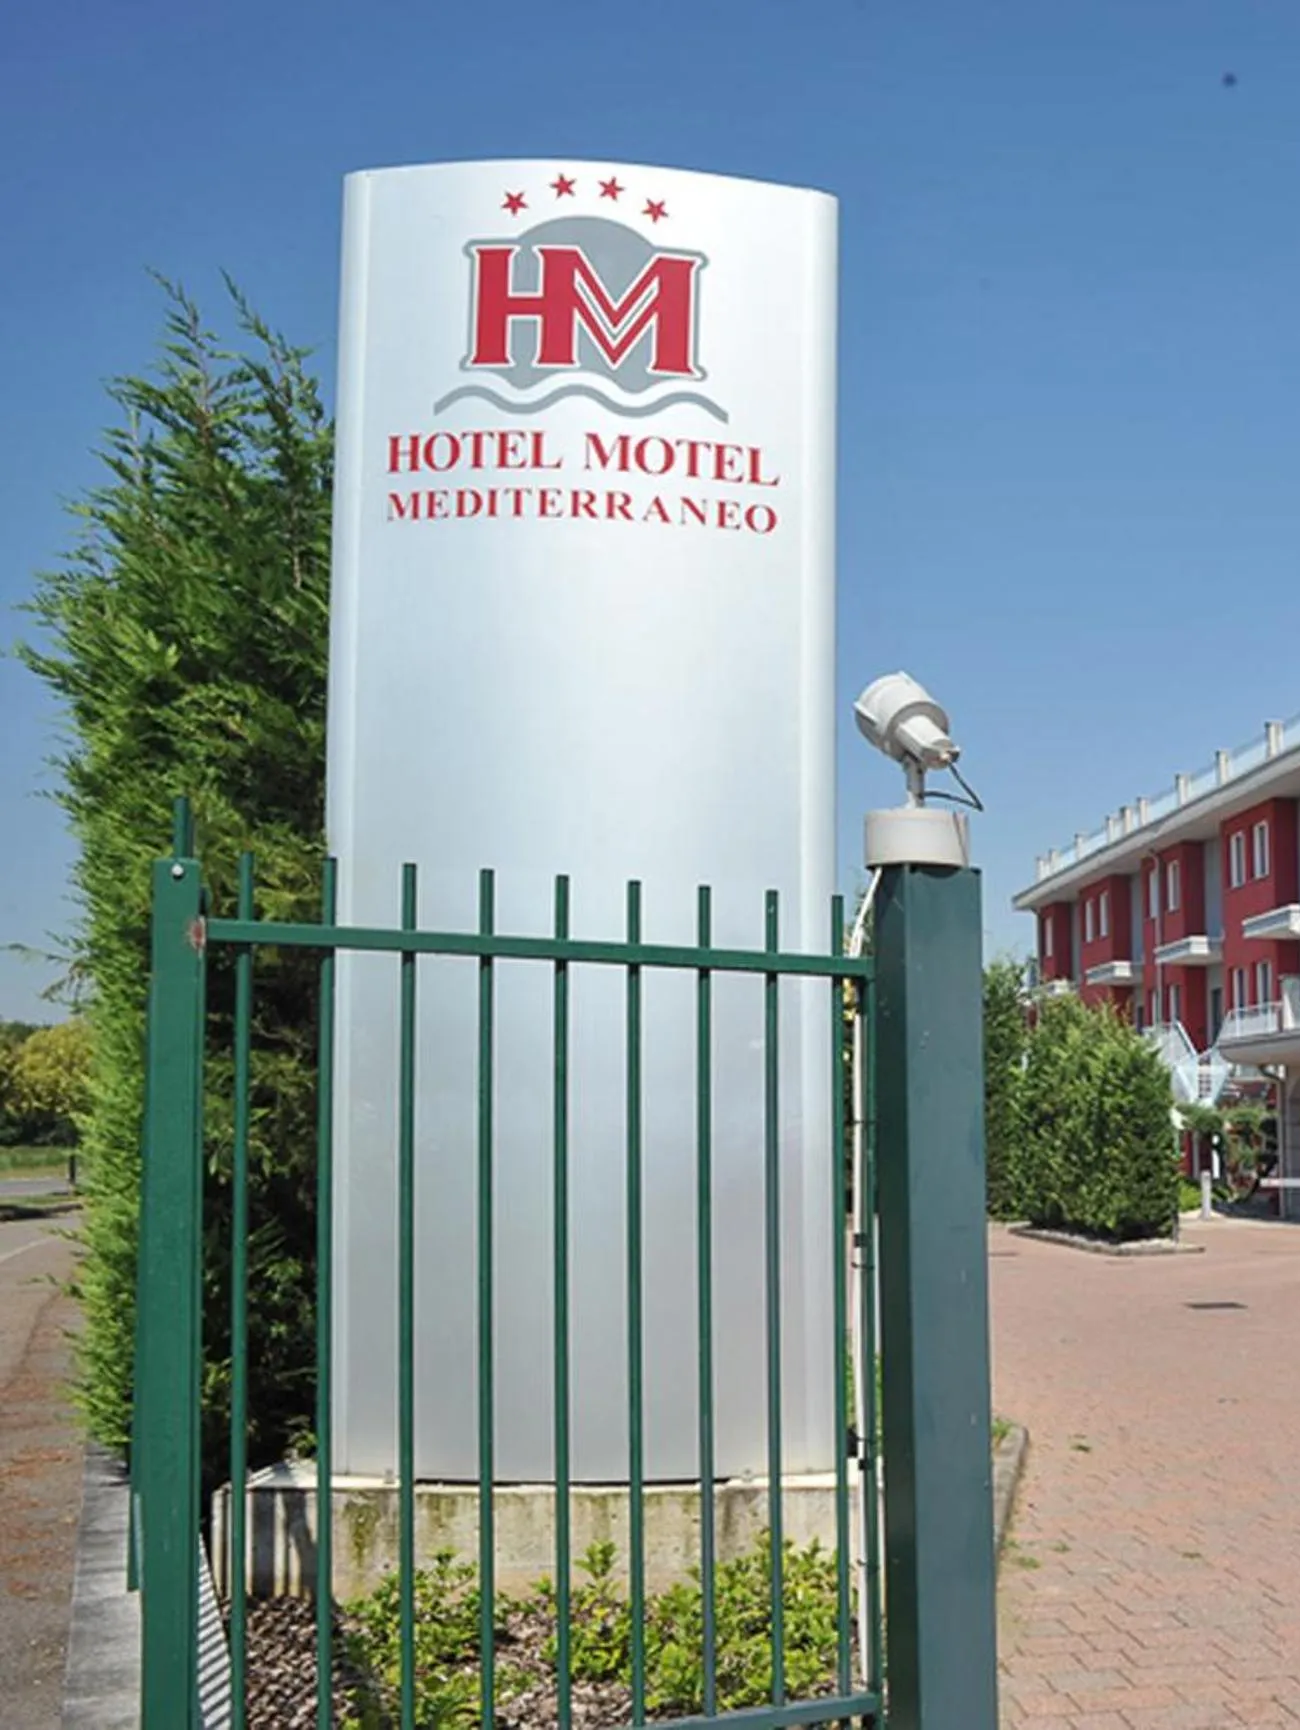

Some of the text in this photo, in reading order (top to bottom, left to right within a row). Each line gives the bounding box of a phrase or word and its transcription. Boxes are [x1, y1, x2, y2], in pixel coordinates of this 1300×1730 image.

[469, 243, 704, 378] HM
[387, 429, 781, 488] HOTEL MOTEL
[386, 487, 778, 535] MEDITERRANEO
